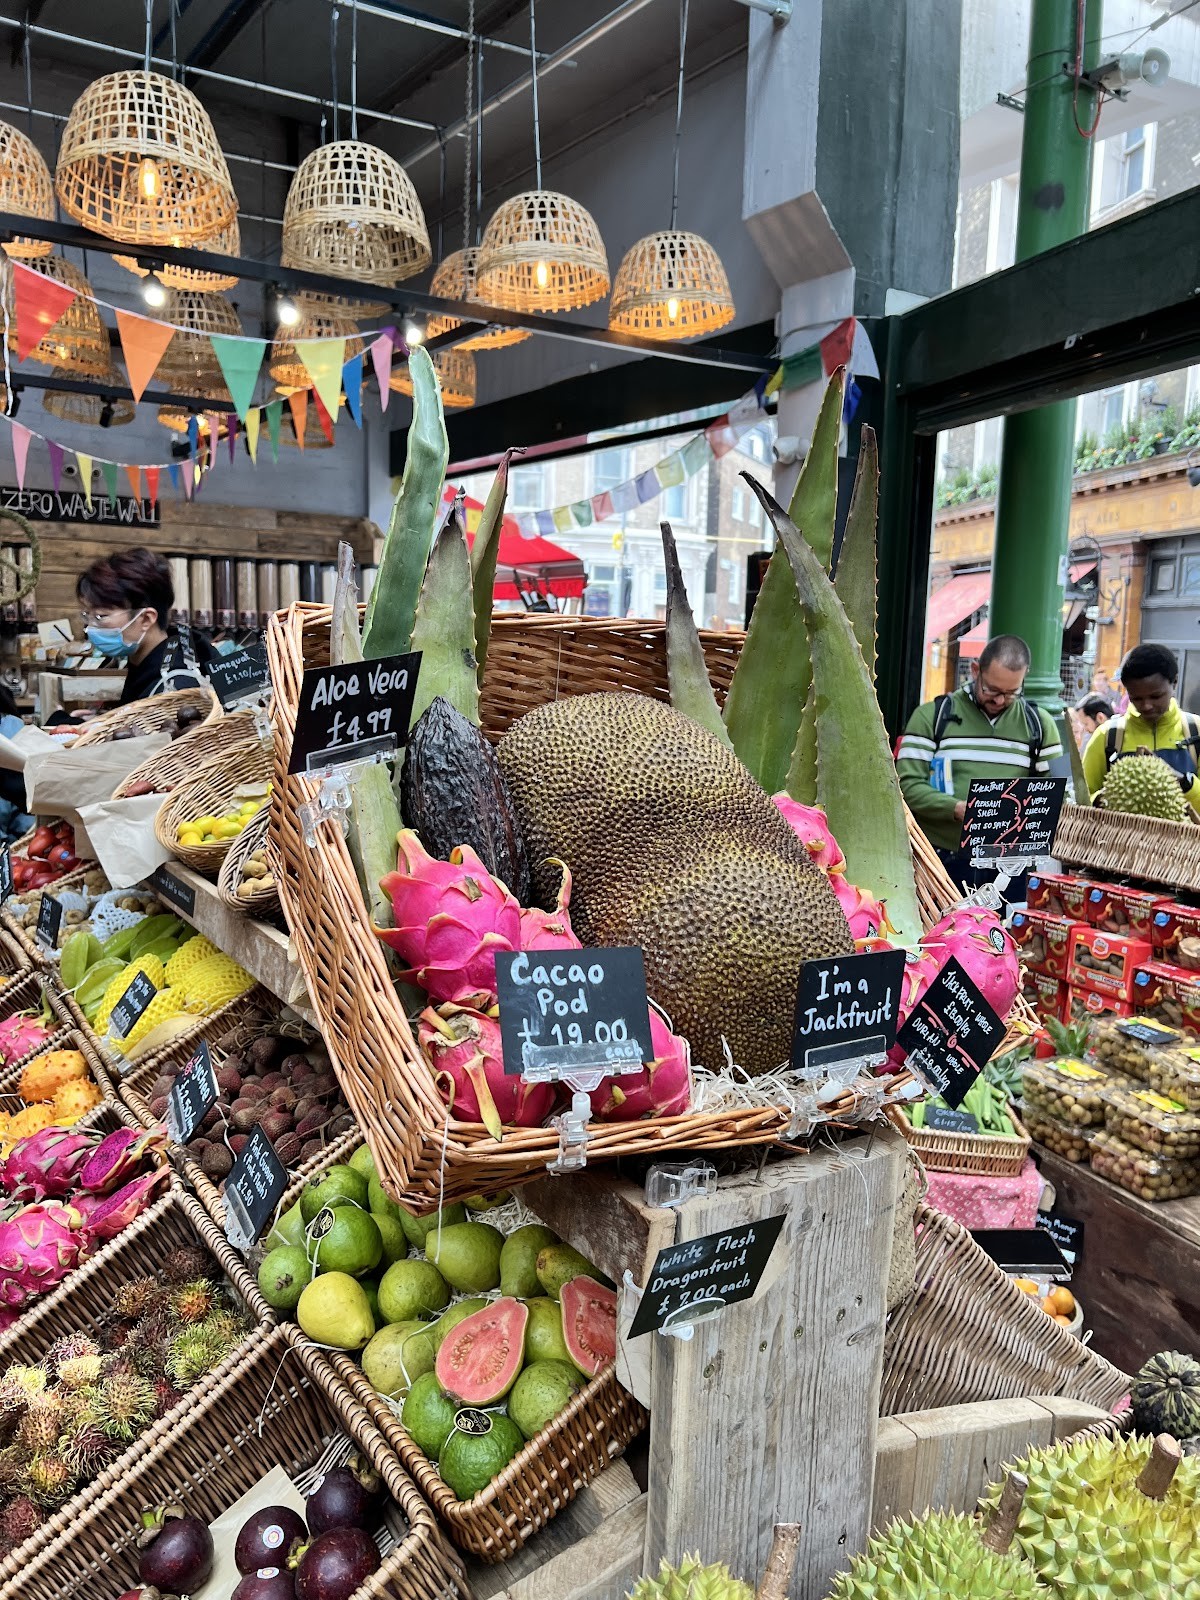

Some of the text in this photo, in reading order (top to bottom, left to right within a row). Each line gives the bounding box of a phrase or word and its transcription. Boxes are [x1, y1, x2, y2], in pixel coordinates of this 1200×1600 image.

[2, 488, 53, 518] ZERO
[55, 492, 118, 521] WASTE
[310, 663, 409, 711] Aloe Vera
[326, 707, 393, 748] £4.99
[510, 951, 605, 986] Cacao
[816, 964, 869, 1001] I'm a
[536, 987, 589, 1017] Pod
[799, 986, 892, 1035] Jackfruit
[249, 1133, 275, 1187] Pink Guava
[650, 1249, 748, 1293] Dragonfruit
[659, 1228, 756, 1273] White Flesh
[719, 1272, 751, 1294] each
